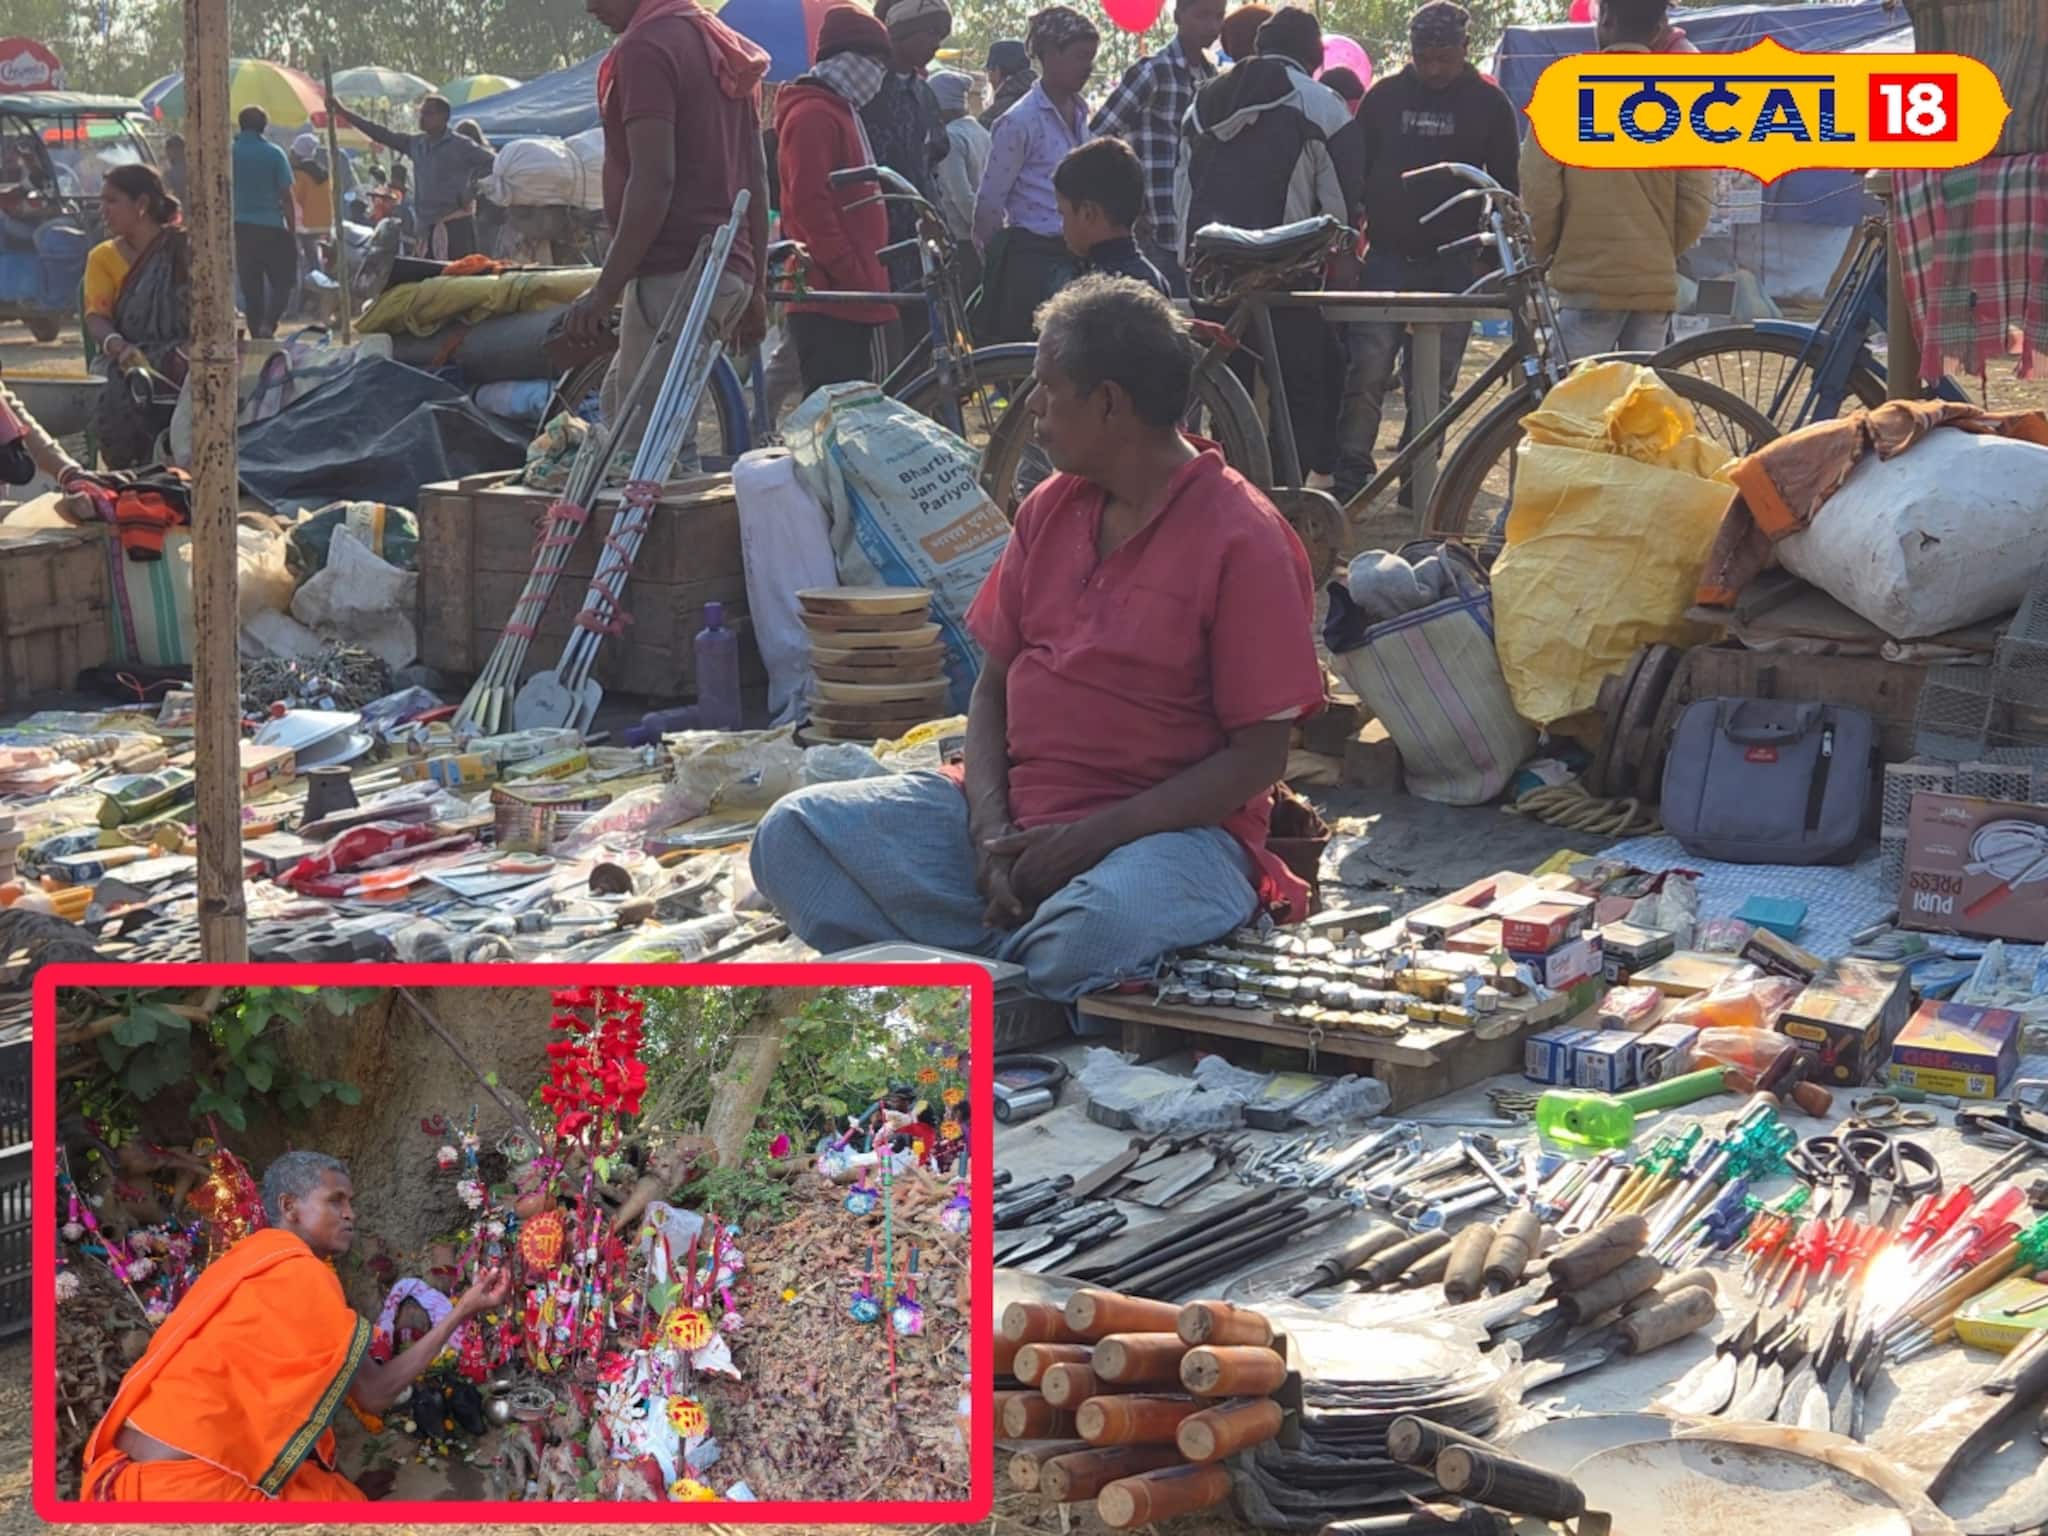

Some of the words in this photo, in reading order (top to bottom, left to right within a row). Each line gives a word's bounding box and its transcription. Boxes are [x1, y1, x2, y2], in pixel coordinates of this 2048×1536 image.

[910, 481, 937, 500] Jan
[1909, 871, 1963, 895] PRESS
[1912, 890, 1953, 915] PURI
